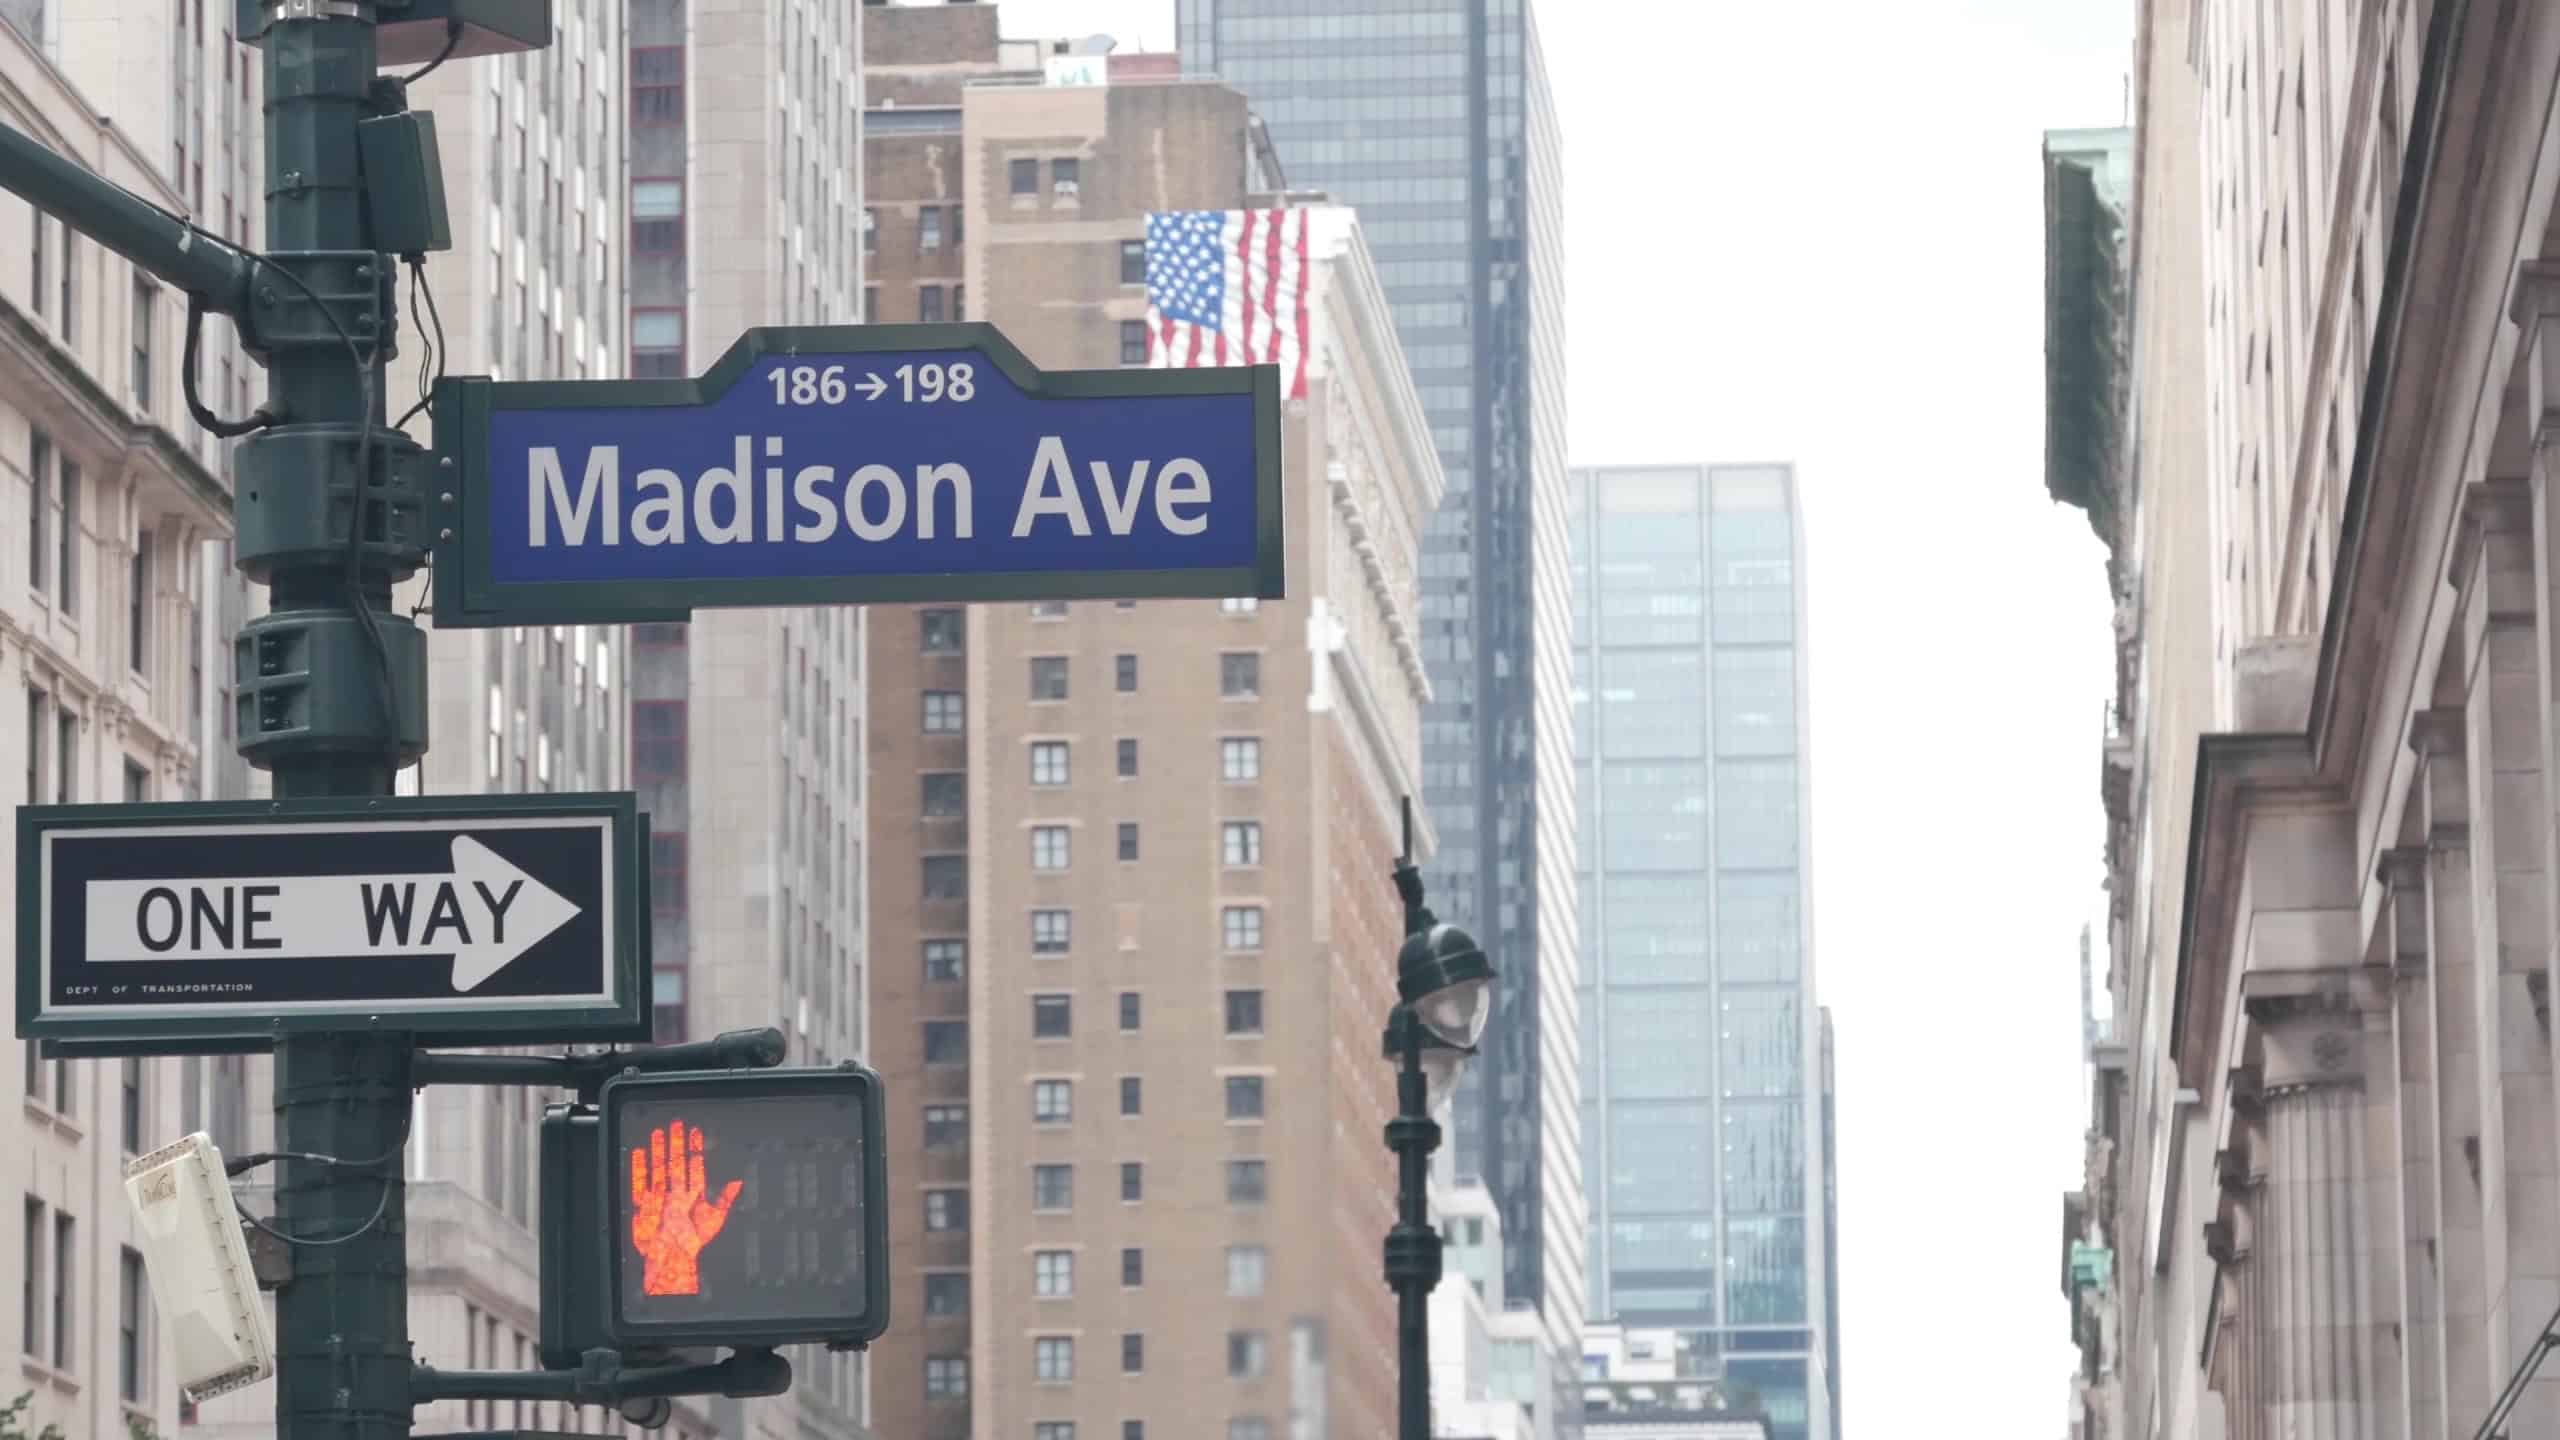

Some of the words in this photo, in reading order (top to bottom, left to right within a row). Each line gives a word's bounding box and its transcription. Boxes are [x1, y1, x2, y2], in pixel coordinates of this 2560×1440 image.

[767, 365, 847, 405] 186
[895, 362, 975, 403] 198
[528, 435, 973, 547] Madison
[1011, 436, 1212, 537] Ave
[136, 885, 283, 953] ONE
[360, 879, 525, 947] WAY
[65, 986, 98, 995] DEPT
[111, 985, 128, 994] OF
[141, 983, 253, 993] TRANSPORTATION
